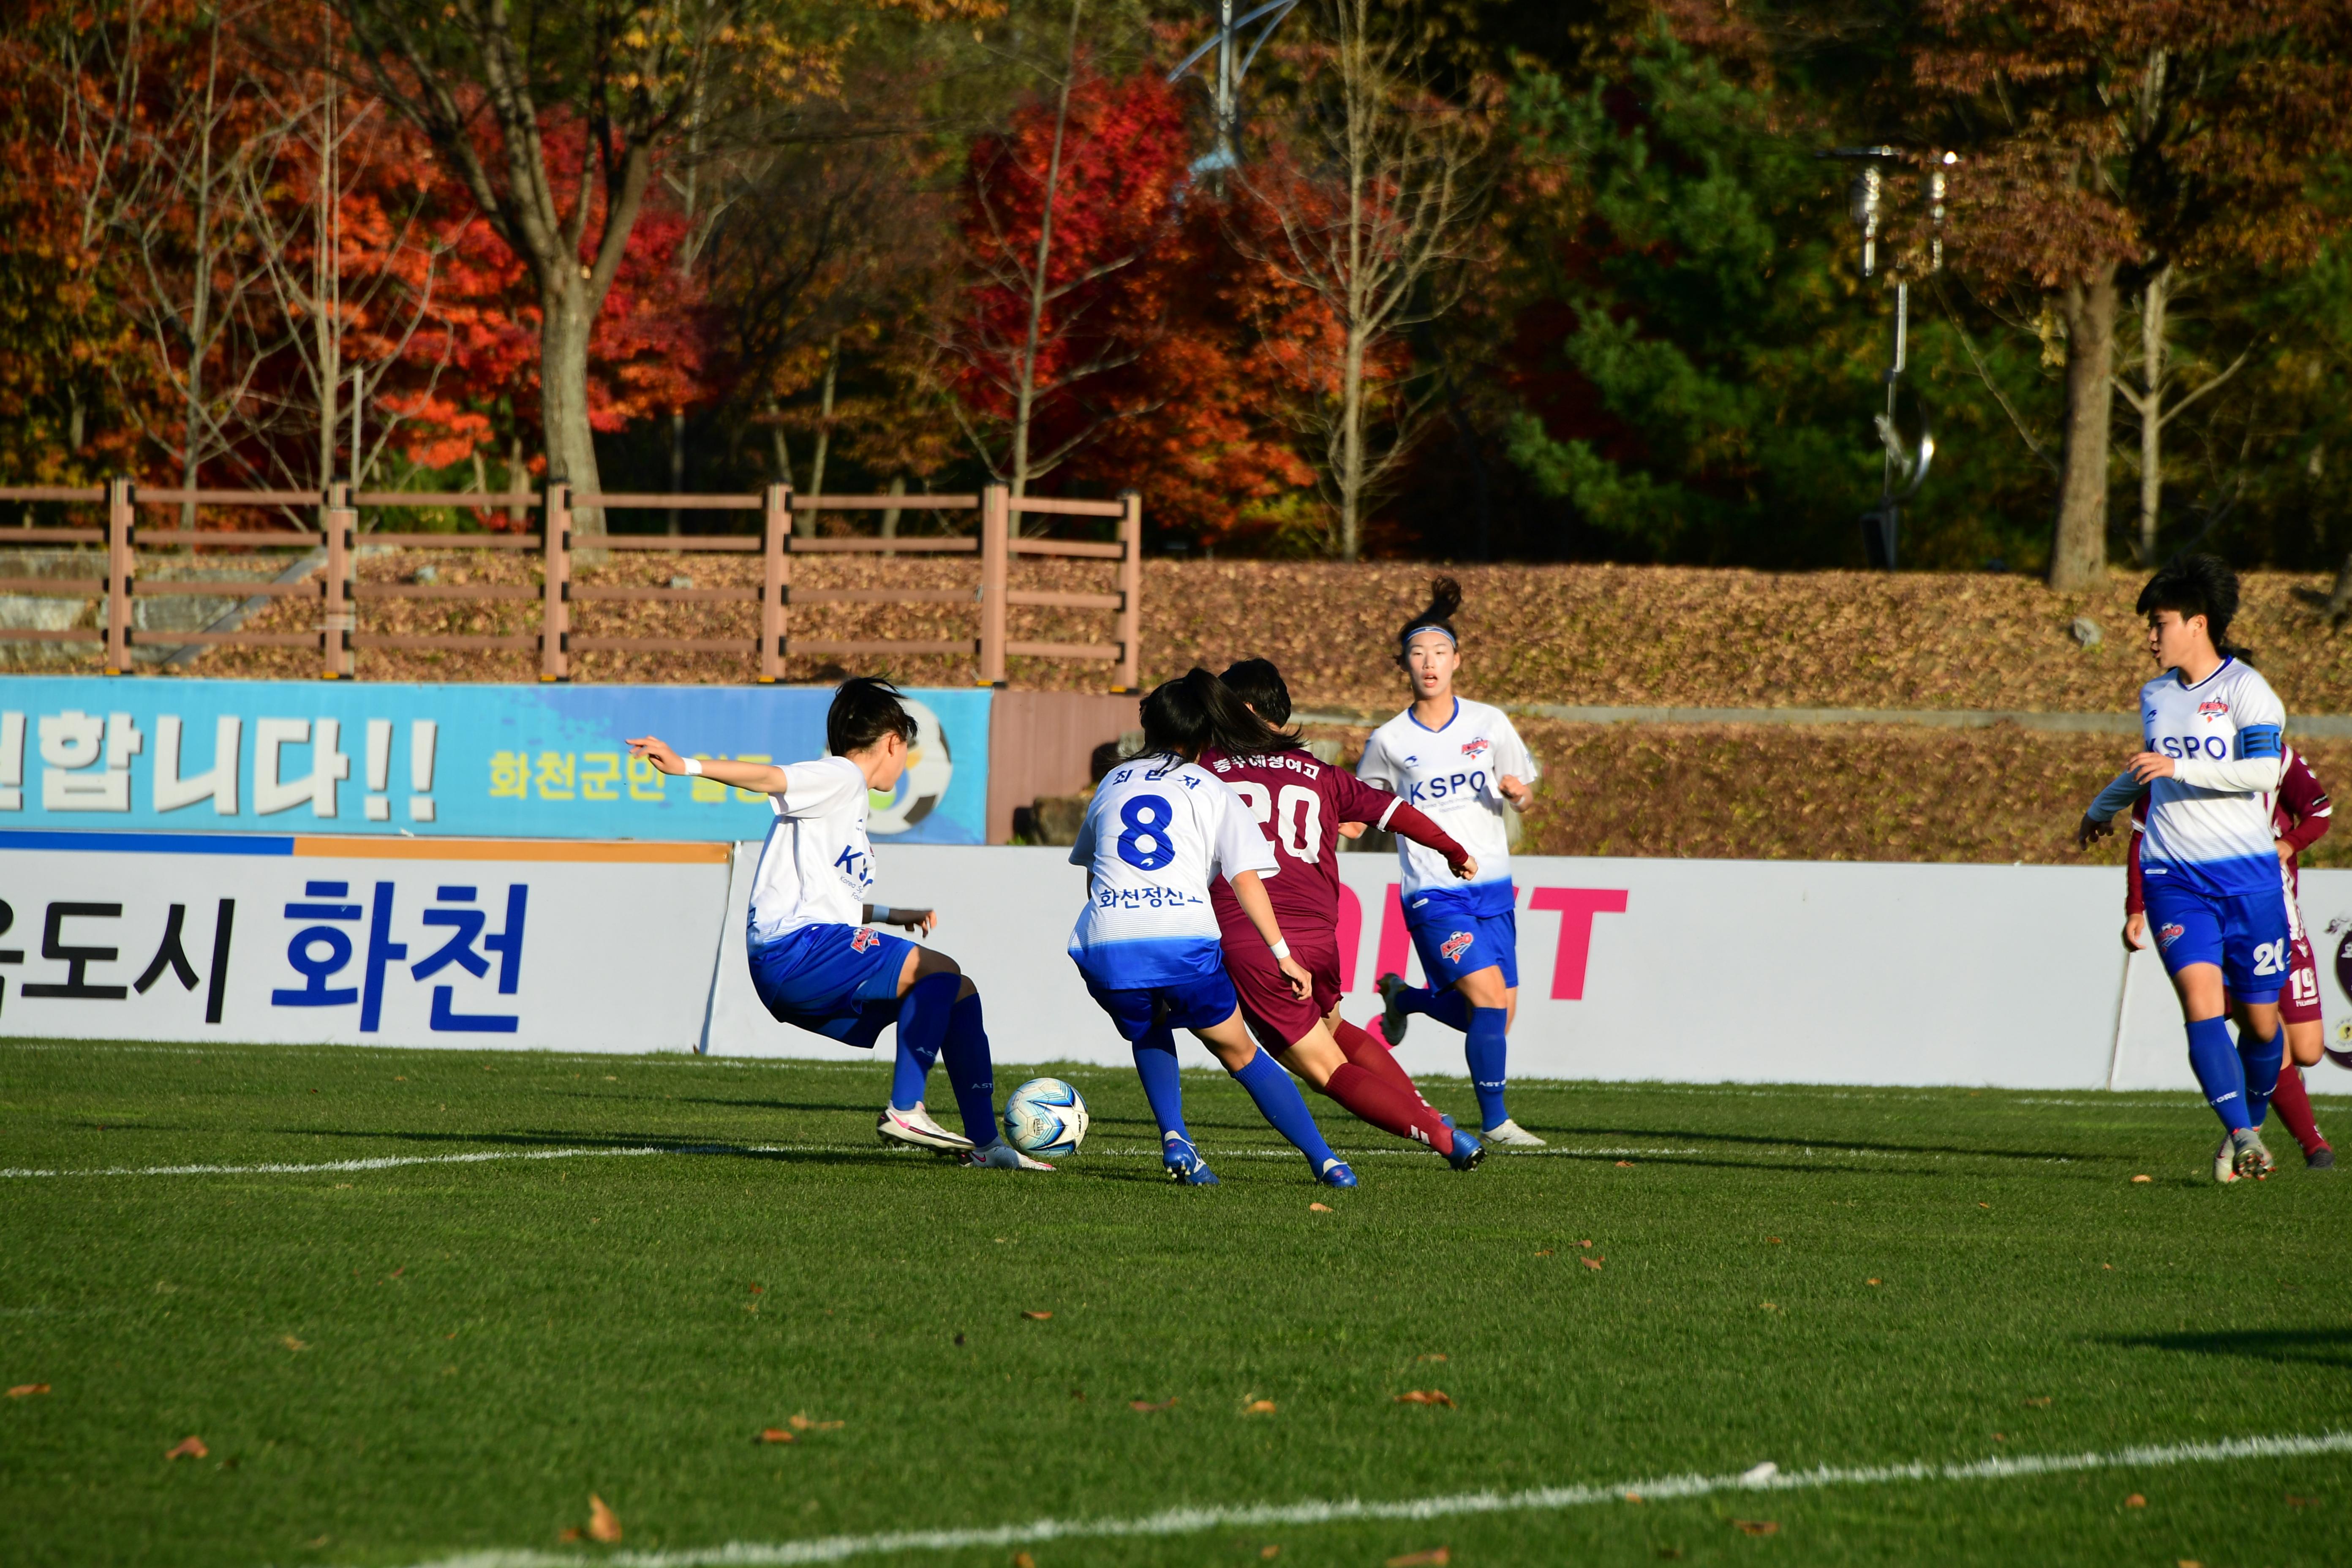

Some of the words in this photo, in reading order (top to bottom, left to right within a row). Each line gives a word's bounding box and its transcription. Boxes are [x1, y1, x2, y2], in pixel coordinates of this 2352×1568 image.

[2145, 736, 2226, 760] KSPO
[489, 751, 666, 800] 화천군민
[1410, 771, 1486, 805] KSPO
[1117, 795, 1176, 871] 8
[271, 881, 528, 1032] 화천
[1441, 932, 1473, 957] KSPO
[2289, 967, 2317, 999] 19
